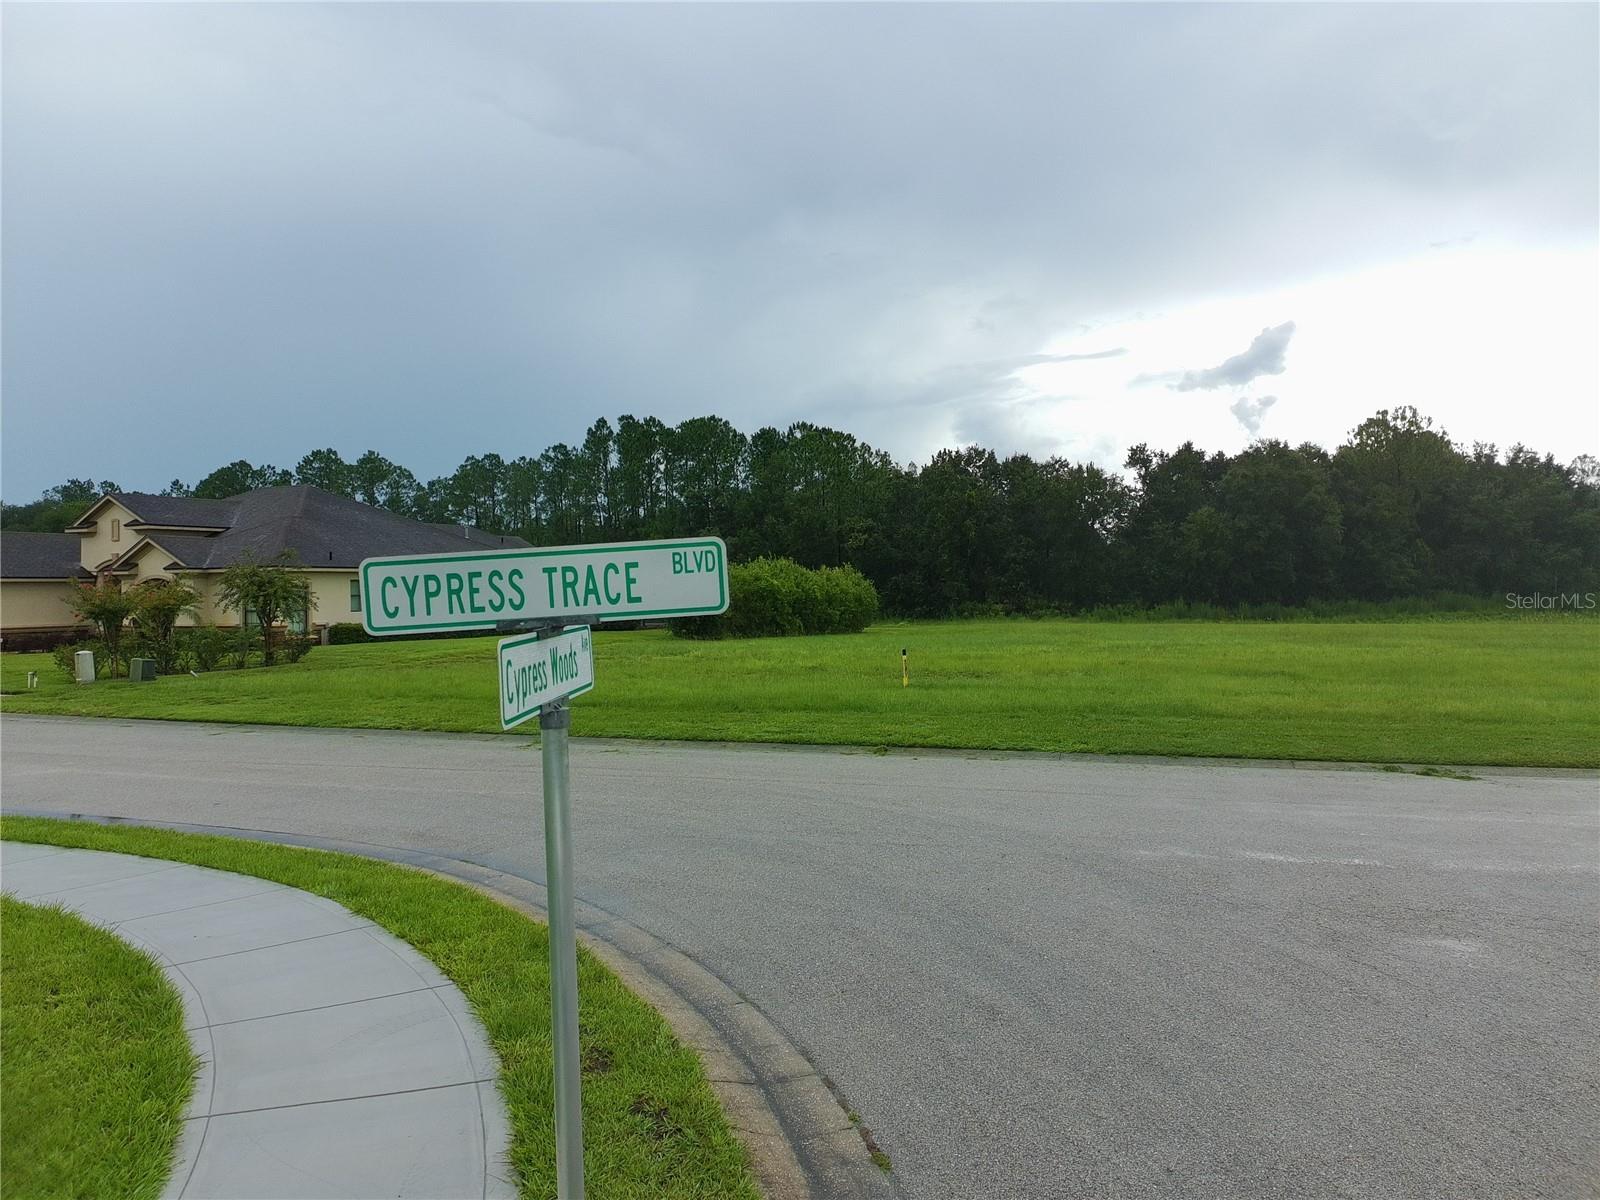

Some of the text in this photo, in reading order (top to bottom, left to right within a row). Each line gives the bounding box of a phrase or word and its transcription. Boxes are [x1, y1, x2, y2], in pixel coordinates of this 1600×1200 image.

[381, 550, 716, 619] CYPRESS TRACE BLVD
[506, 659, 548, 713] Cypress
[549, 643, 578, 686] Woods
